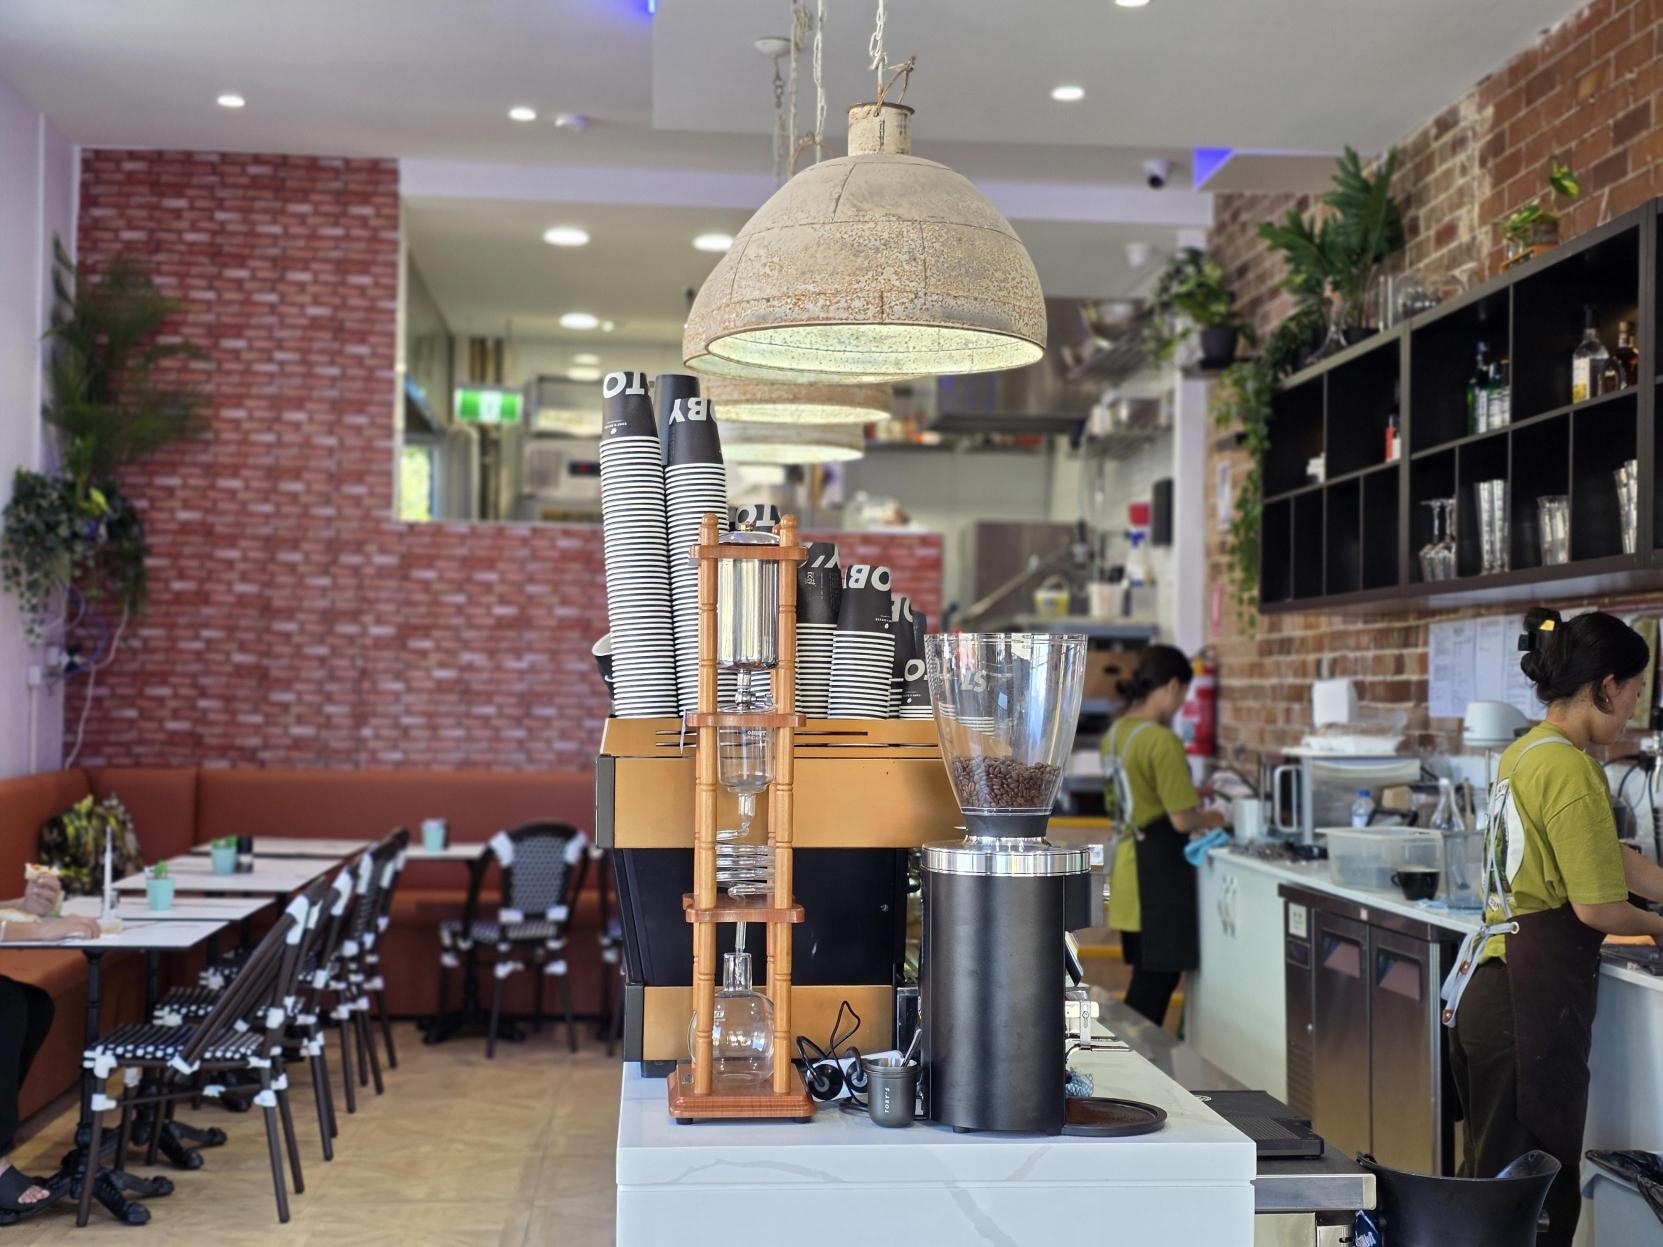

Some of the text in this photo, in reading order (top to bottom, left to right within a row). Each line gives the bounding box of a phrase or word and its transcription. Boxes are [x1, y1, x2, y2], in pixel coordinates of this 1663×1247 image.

[603, 371, 645, 399] TO
[669, 397, 717, 425] BY
[842, 564, 891, 592] OB
[904, 658, 928, 682] O
